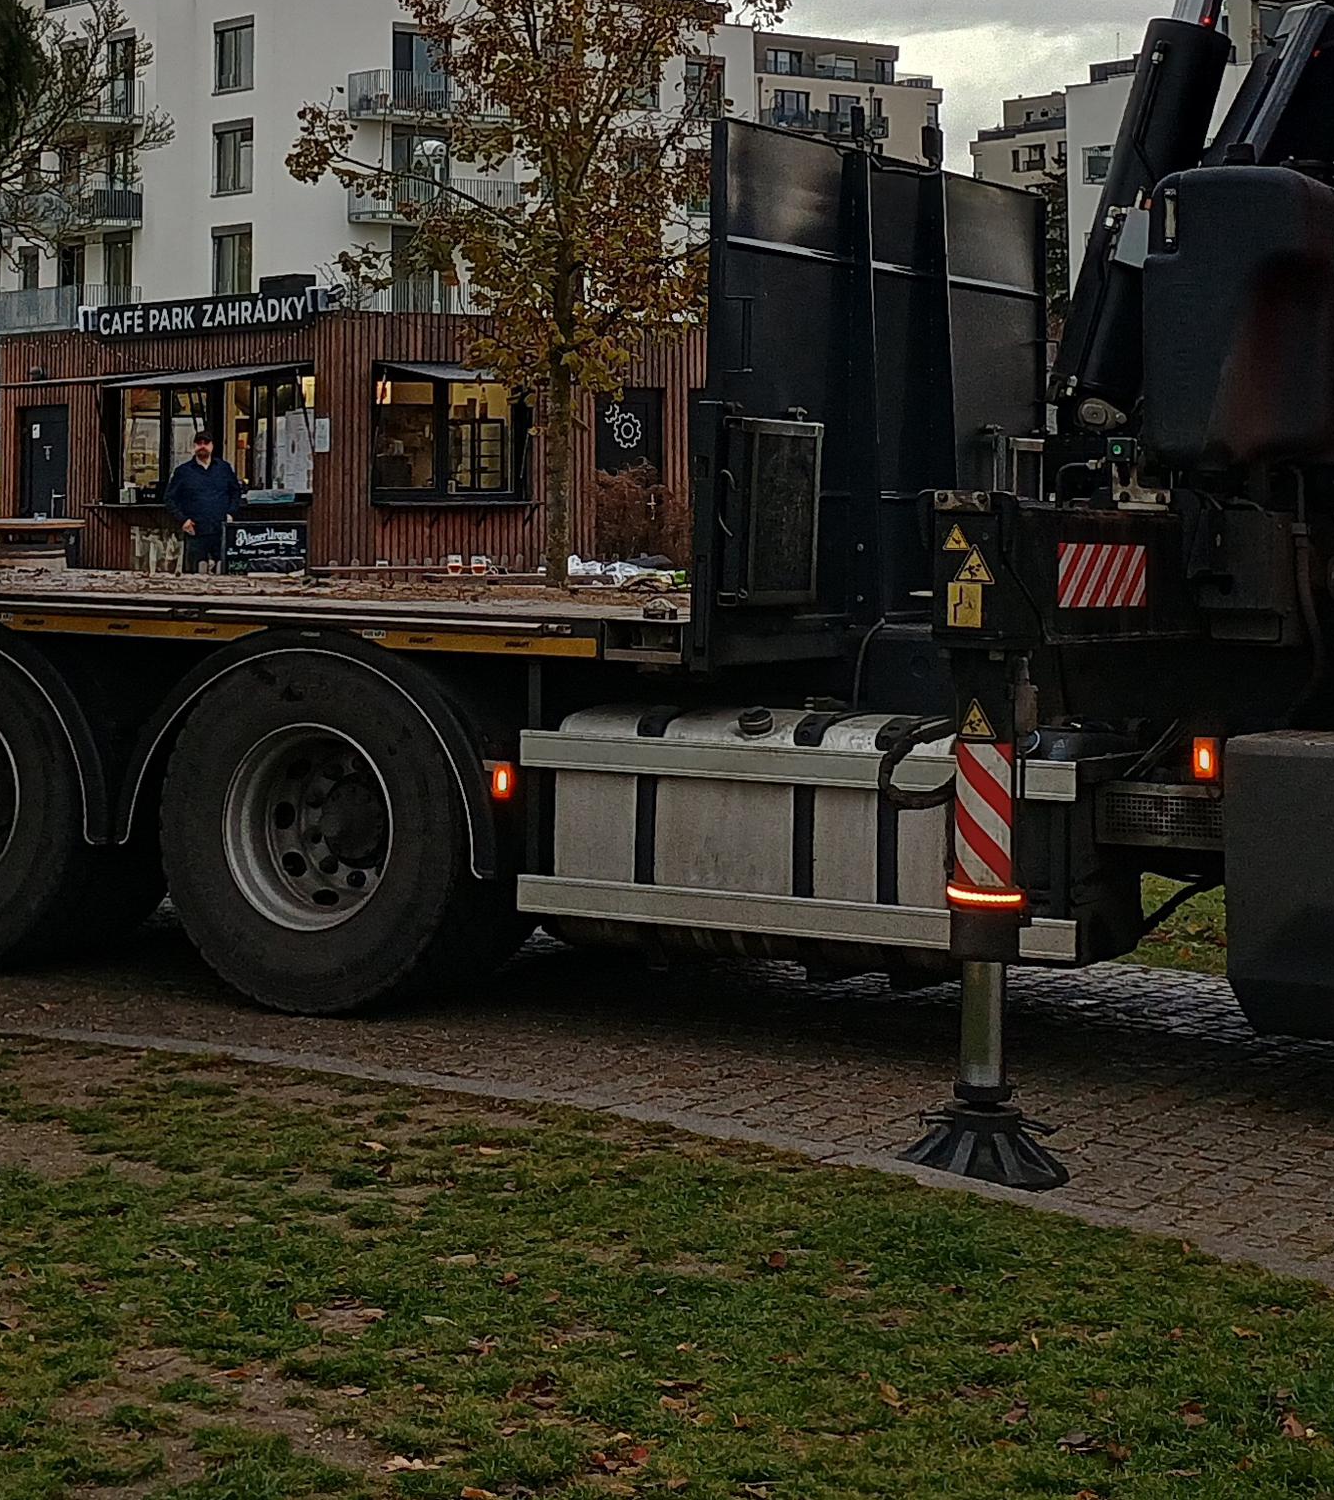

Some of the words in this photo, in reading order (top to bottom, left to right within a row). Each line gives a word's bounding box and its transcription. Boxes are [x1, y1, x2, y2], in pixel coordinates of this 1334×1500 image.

[99, 304, 144, 336] CAFÉ
[149, 305, 196, 332] PARK
[202, 293, 307, 328] ZAHRÁDKY
